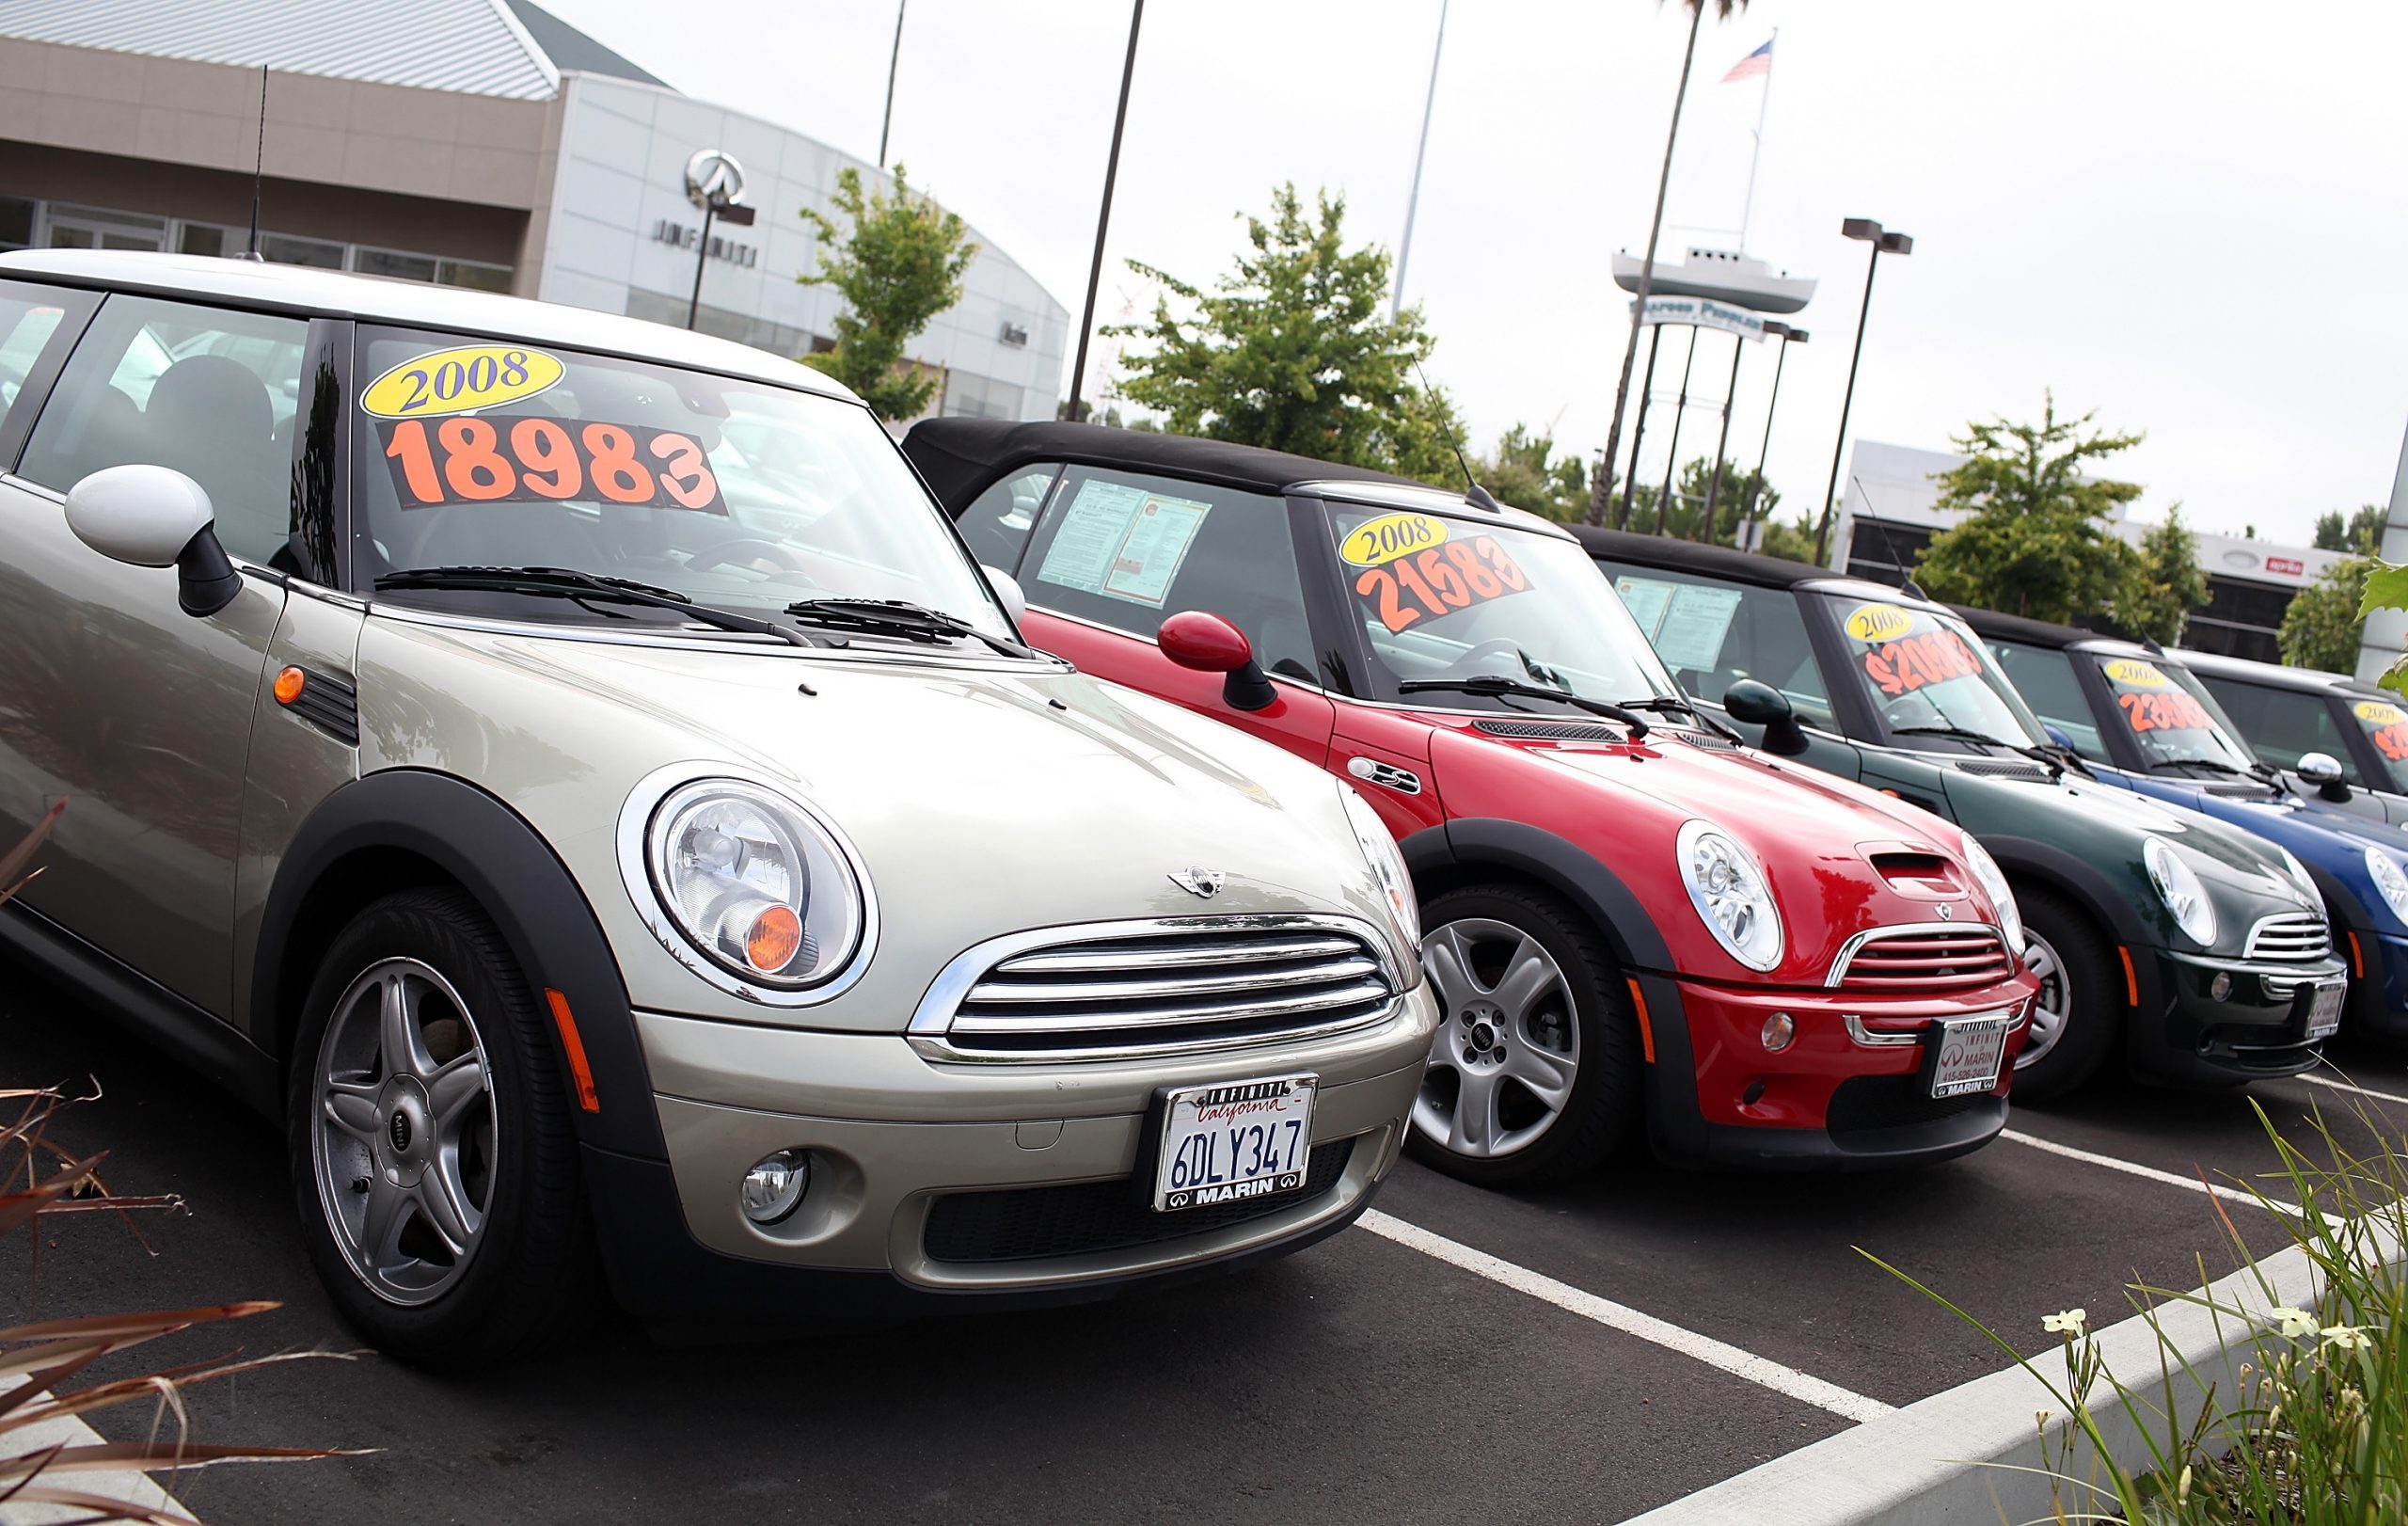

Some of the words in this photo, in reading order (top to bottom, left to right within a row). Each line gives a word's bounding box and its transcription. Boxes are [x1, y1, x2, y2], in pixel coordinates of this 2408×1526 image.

[653, 219, 757, 268] INFNITI
[399, 351, 529, 413] 2008
[386, 418, 717, 510] 18983
[1361, 517, 1432, 562] 2008
[1355, 536, 1525, 632] 21583
[1859, 608, 1905, 639] 2008
[1966, 1032, 2001, 1046] INFINIT
[1964, 1051, 1994, 1067] MARIN
[1210, 1082, 1283, 1104] INFINITI
[1948, 1081, 1982, 1095] MARIN
[1197, 1098, 1288, 1126] California
[395, 1115, 404, 1147] MINI
[1170, 1120, 1302, 1189] 6DLY347
[1196, 1178, 1275, 1205] MARIN
